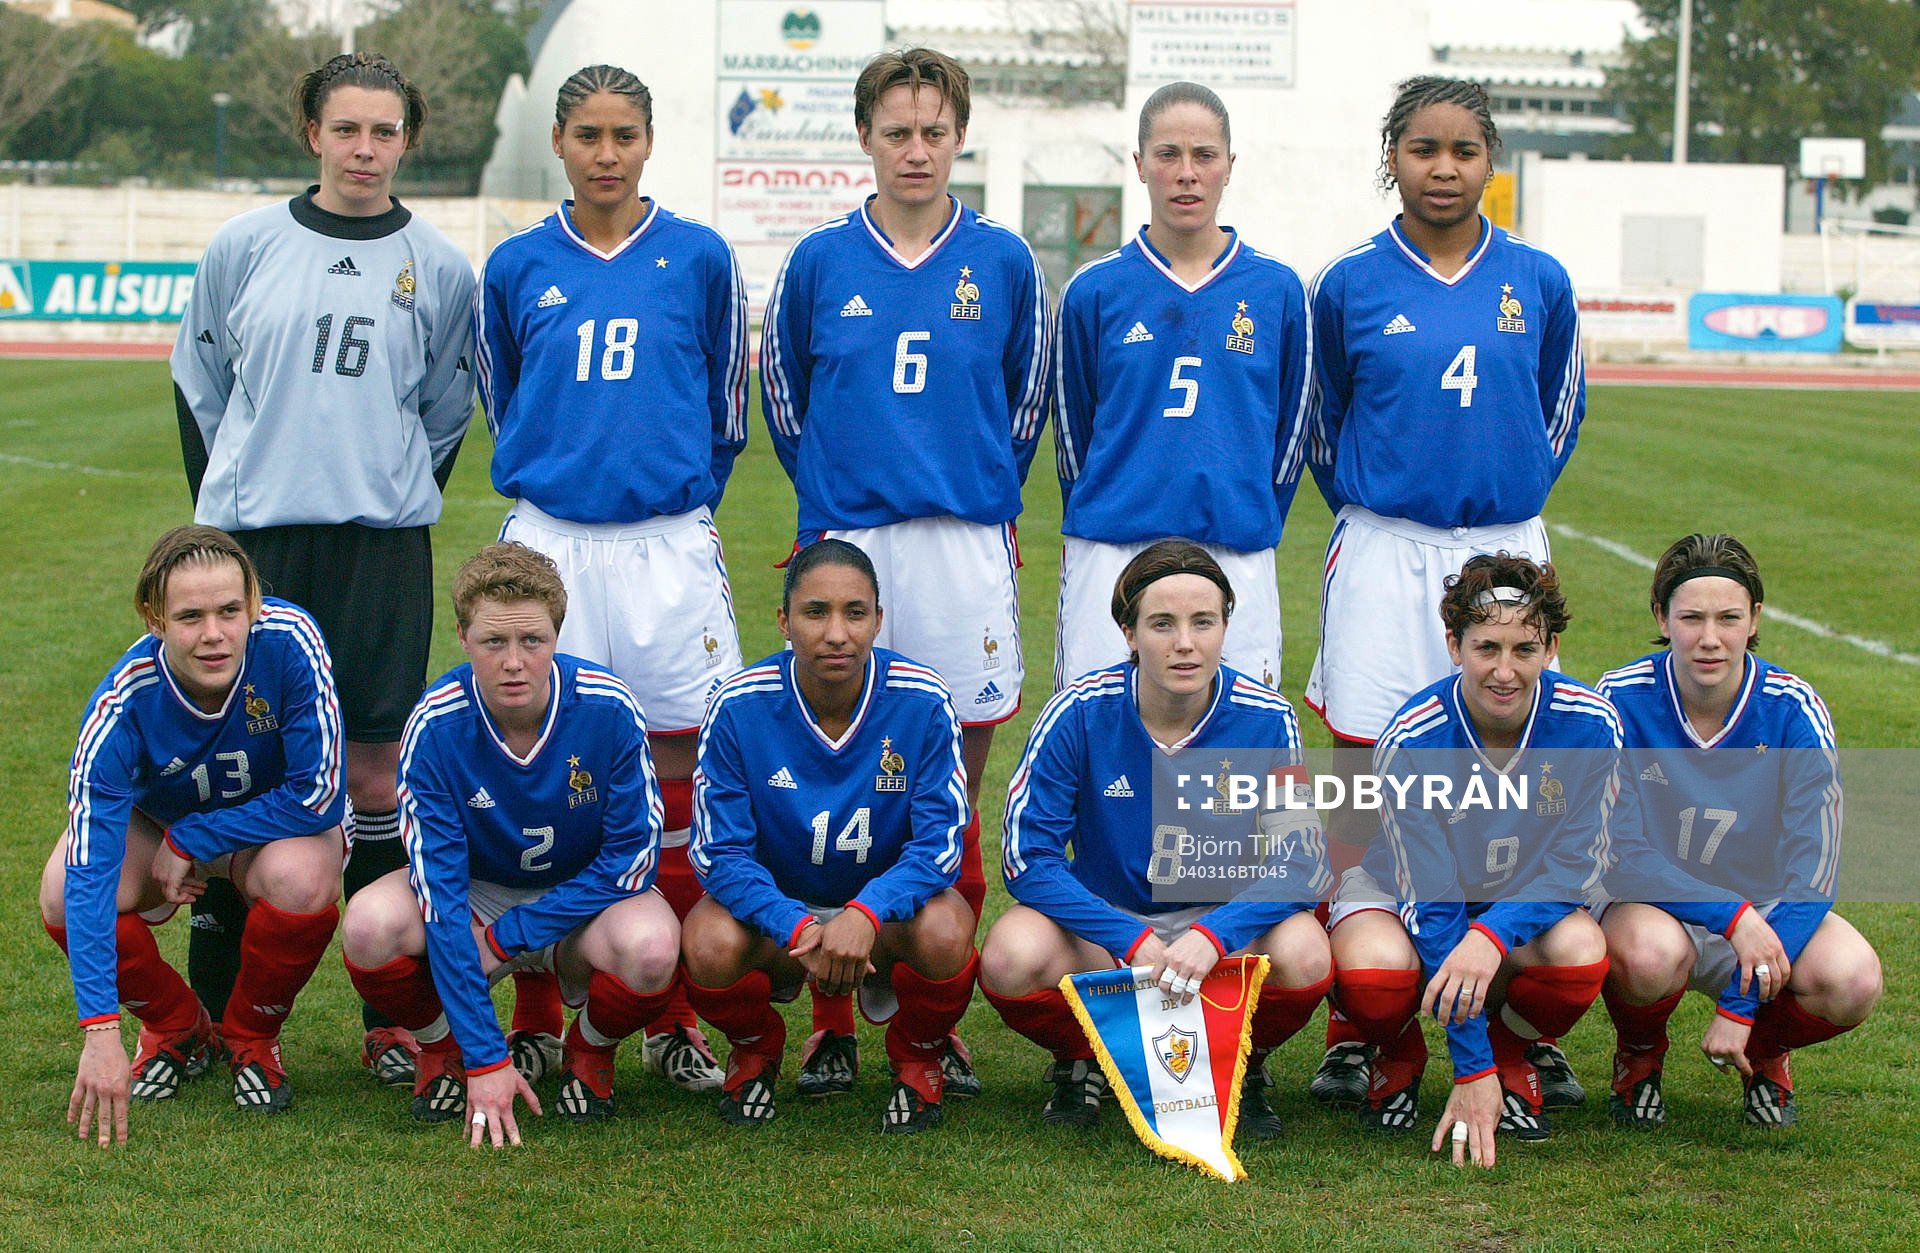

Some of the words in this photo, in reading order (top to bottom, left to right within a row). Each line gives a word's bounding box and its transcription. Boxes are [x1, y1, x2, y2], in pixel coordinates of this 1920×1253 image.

[723, 55, 864, 71] MARRACHINH
[328, 267, 361, 276] adidas
[538, 296, 568, 308] adidas
[840, 308, 873, 317] adidas
[1123, 333, 1154, 344] adidas
[1383, 325, 1417, 336] adidas
[312, 313, 375, 377] 16
[576, 318, 639, 382] 18
[892, 331, 931, 394] 6
[1440, 345, 1478, 408] 4
[1163, 356, 1202, 418] 5
[974, 693, 1004, 705] adidas
[191, 750, 252, 802] 13
[768, 778, 798, 789] adidas
[1103, 788, 1135, 798] adidas
[467, 799, 496, 809] adidas
[811, 807, 873, 865] 14
[1677, 807, 1738, 865] 17
[520, 825, 555, 872] 2
[1147, 824, 1188, 885] 8
[1482, 836, 1520, 889] 9
[1161, 999, 1178, 1012] DE
[1154, 1095, 1220, 1114] FOOTBALL
